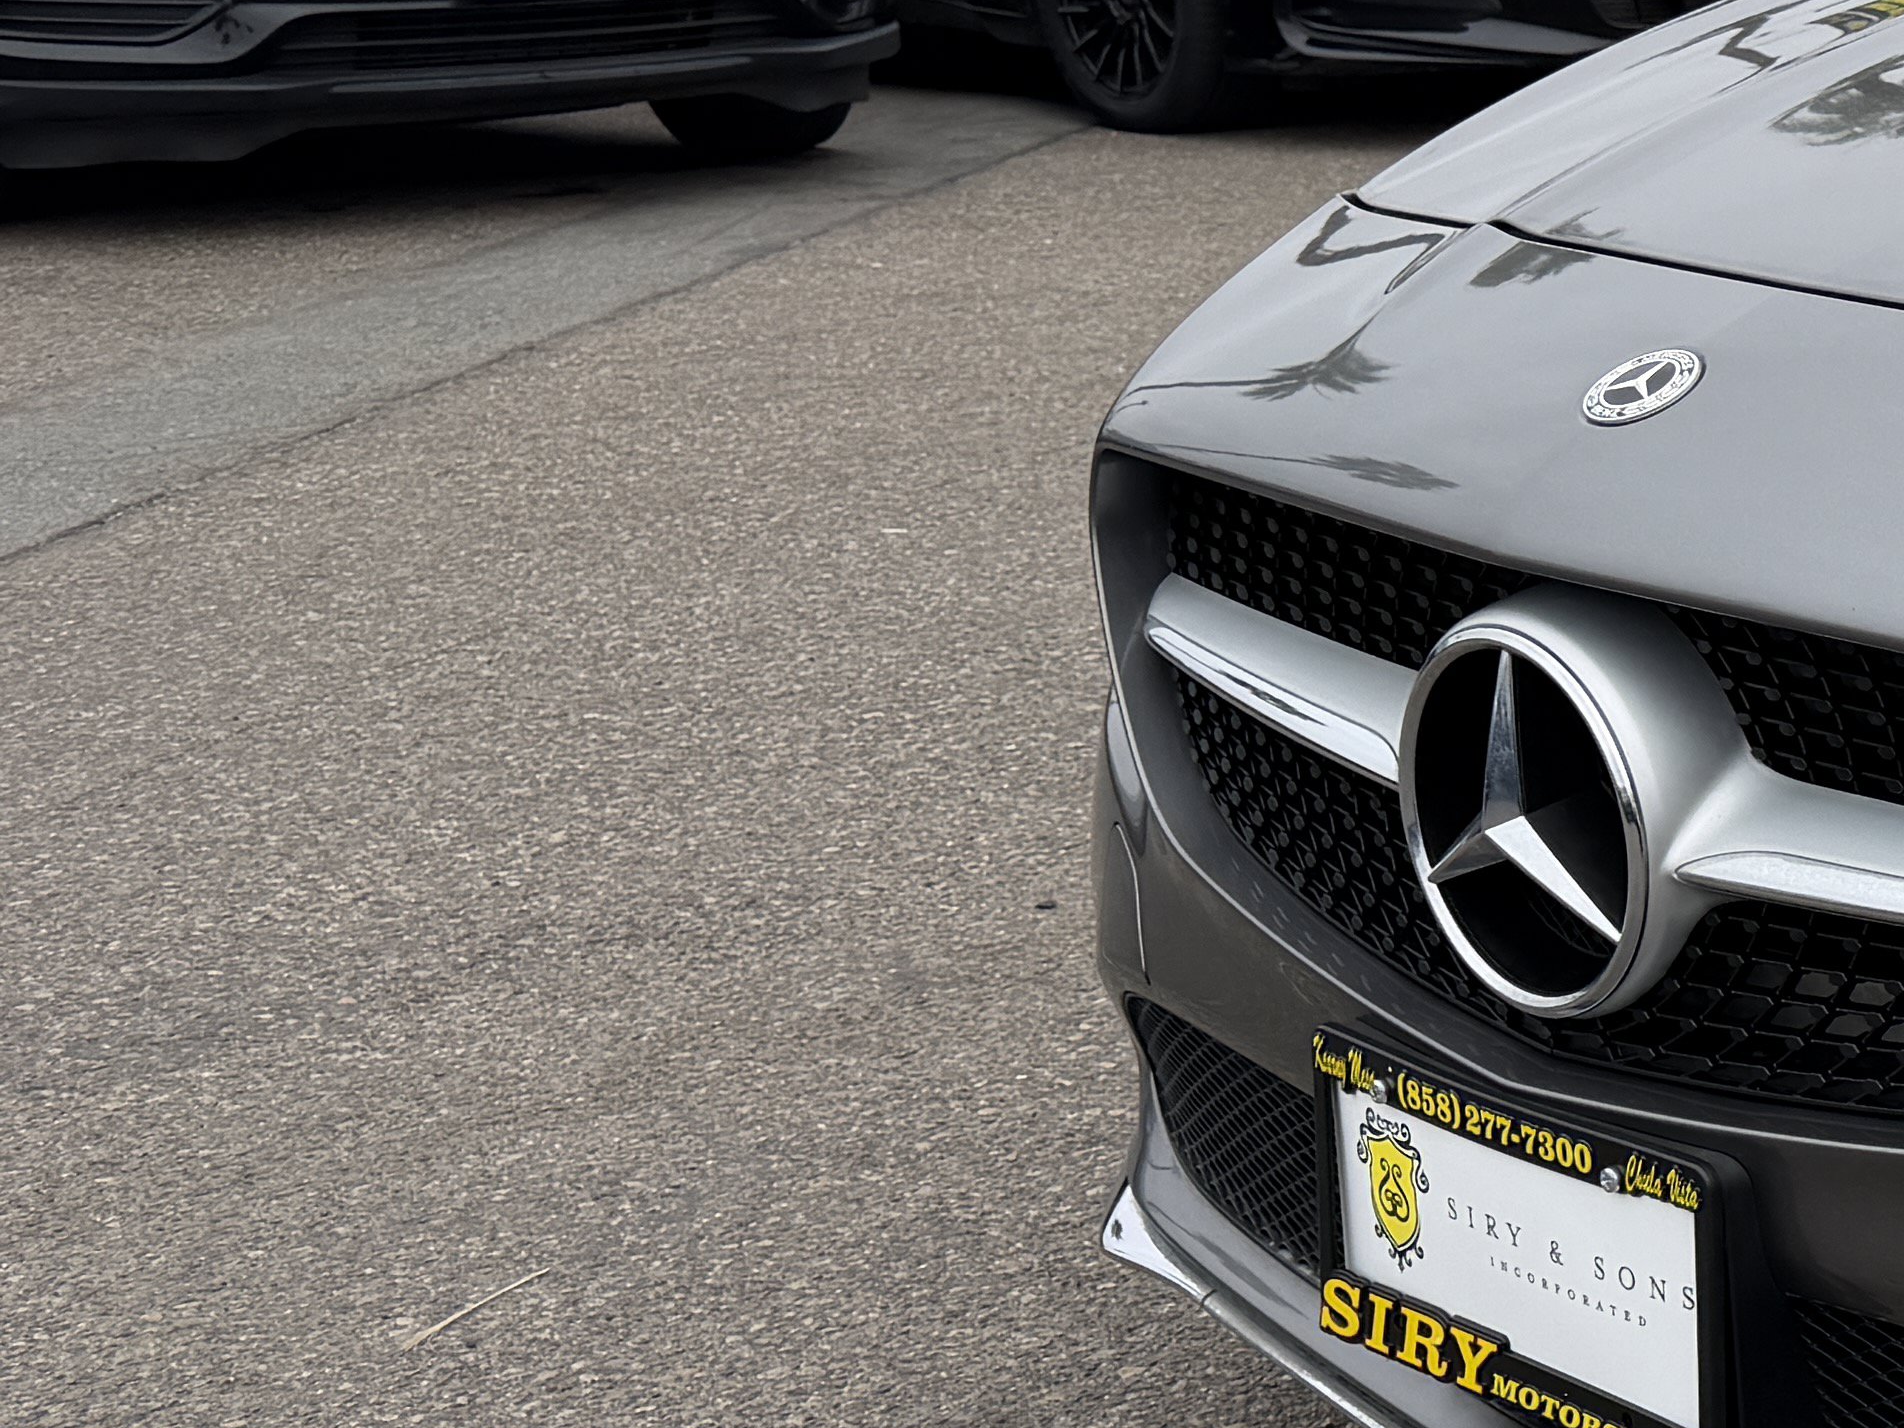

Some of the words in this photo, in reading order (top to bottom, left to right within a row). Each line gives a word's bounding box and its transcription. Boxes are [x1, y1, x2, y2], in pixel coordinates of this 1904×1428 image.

[1397, 1072, 1461, 1129] (858)
[1465, 1104, 1592, 1174] 277-7300
[1625, 1154, 1663, 1197] Chula
[1667, 1167, 1701, 1210] Vista
[1447, 1197, 1521, 1247] SIRY
[1549, 1240, 1564, 1266] &
[1593, 1255, 1695, 1310] SONS
[1490, 1256, 1647, 1327] INCORPORATED
[1319, 1278, 1499, 1395] SIRY
